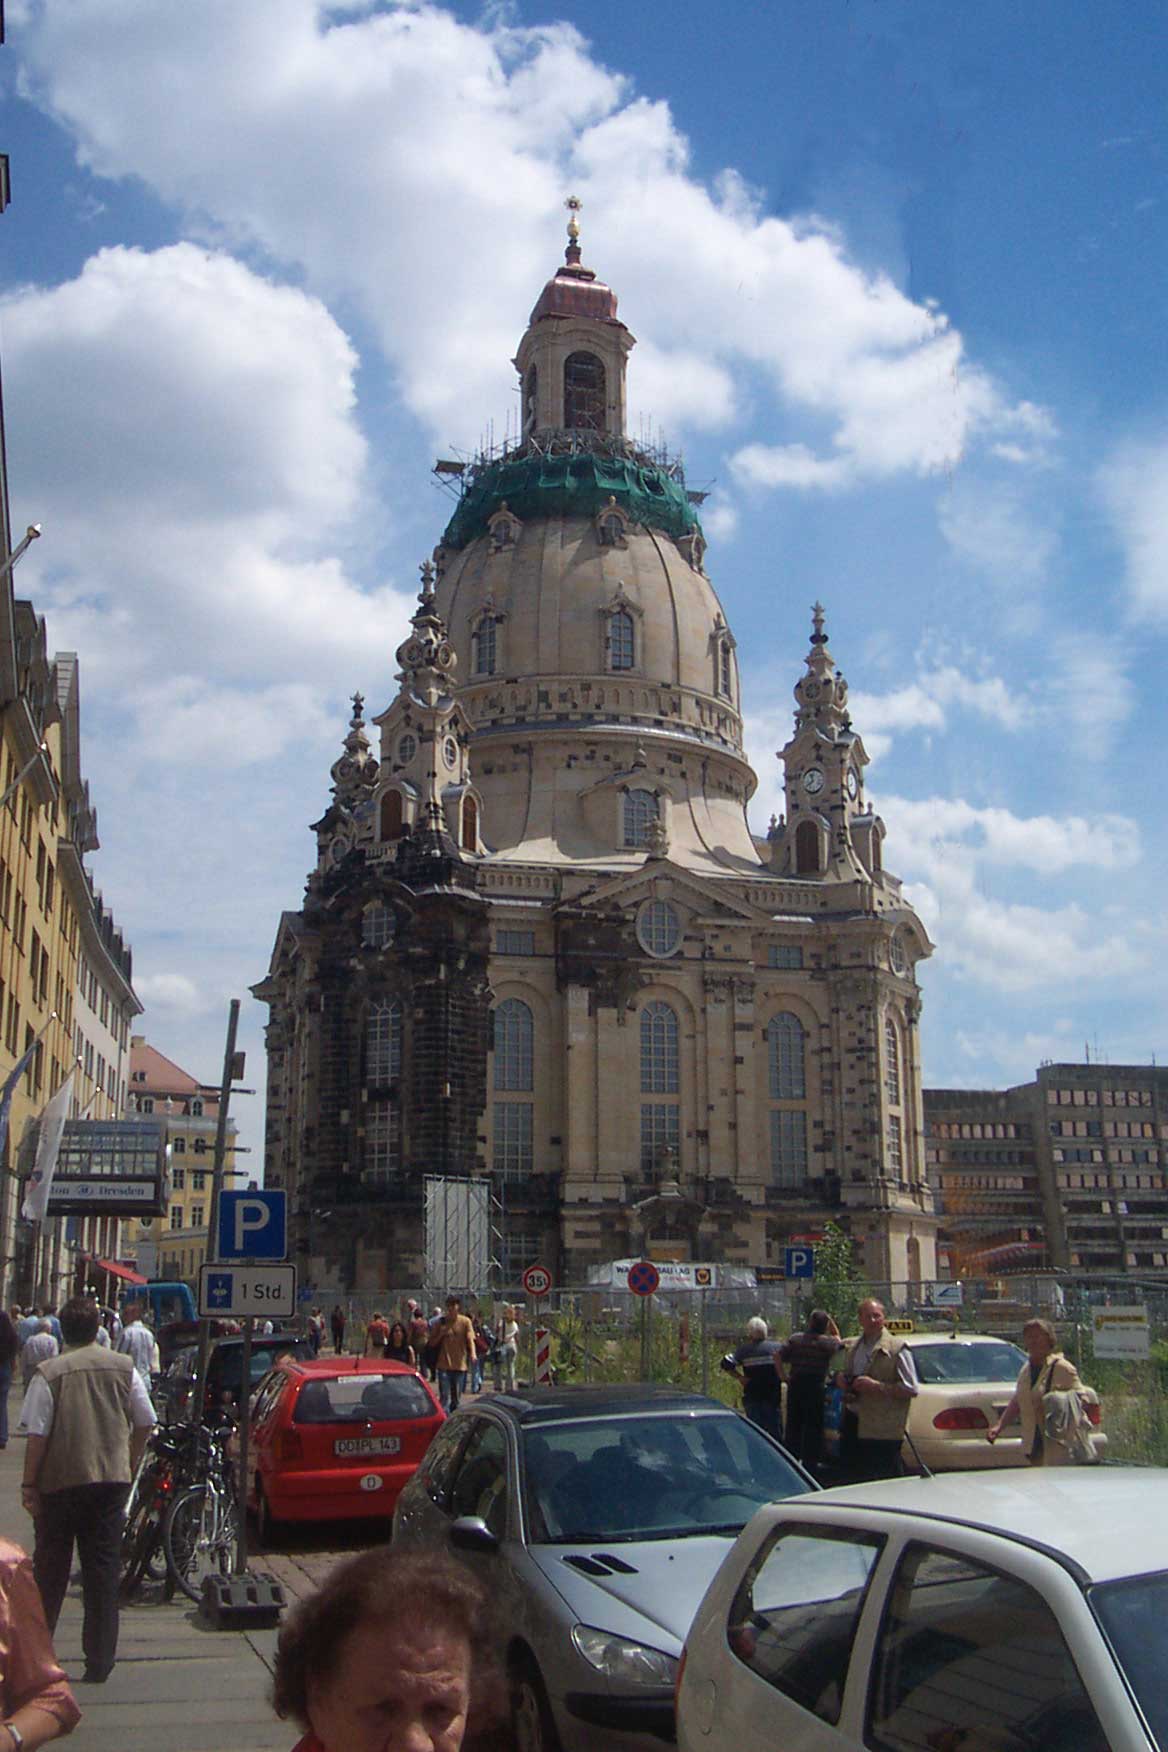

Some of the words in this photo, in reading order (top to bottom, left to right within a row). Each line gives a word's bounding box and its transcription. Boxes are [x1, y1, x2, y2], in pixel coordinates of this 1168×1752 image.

[235, 1199, 270, 1251] P
[792, 1251, 807, 1275] P
[242, 1284, 248, 1299] 1
[254, 1284, 285, 1299] Std.
